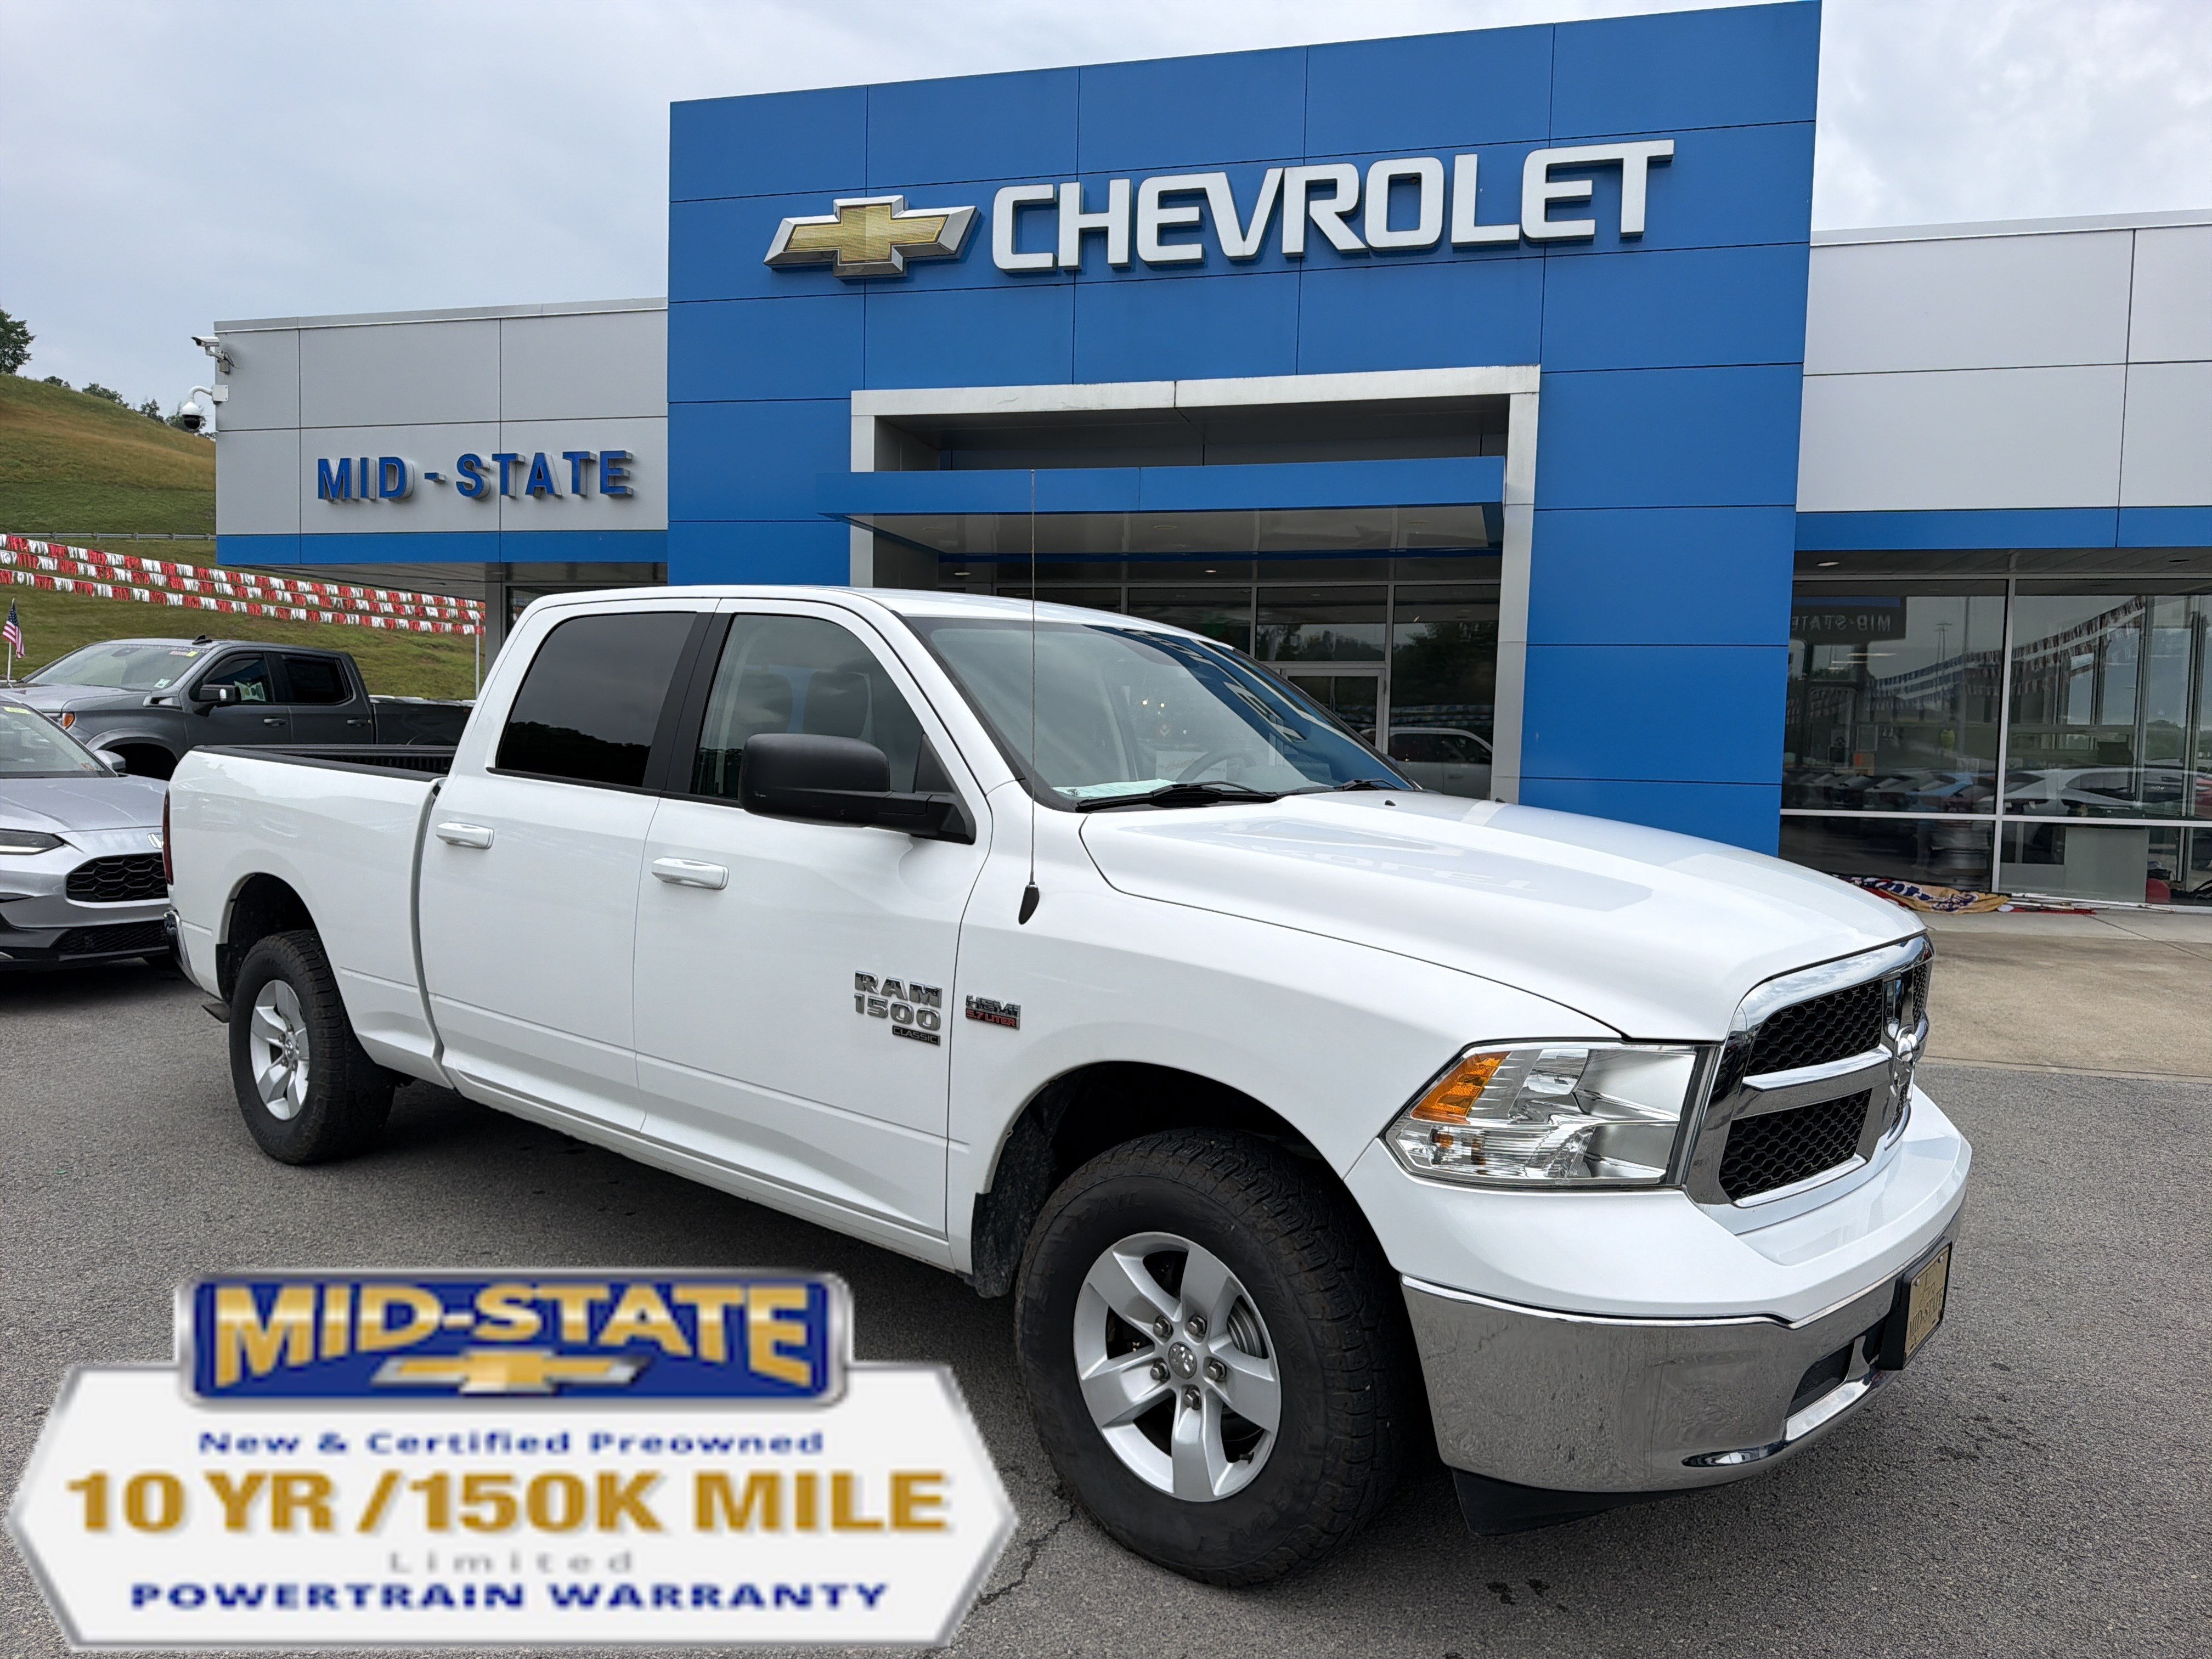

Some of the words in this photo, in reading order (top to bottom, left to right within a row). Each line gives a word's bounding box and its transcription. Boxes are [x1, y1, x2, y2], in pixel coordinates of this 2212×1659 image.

[992, 138, 1675, 272] CHEVROLET
[854, 970, 943, 1008] RAM
[854, 992, 941, 1031] 1500
[966, 994, 1022, 1017] HEMI
[967, 1009, 984, 1020] 5.7
[985, 1013, 1017, 1028] LITER
[893, 1026, 939, 1045] CLASSIC
